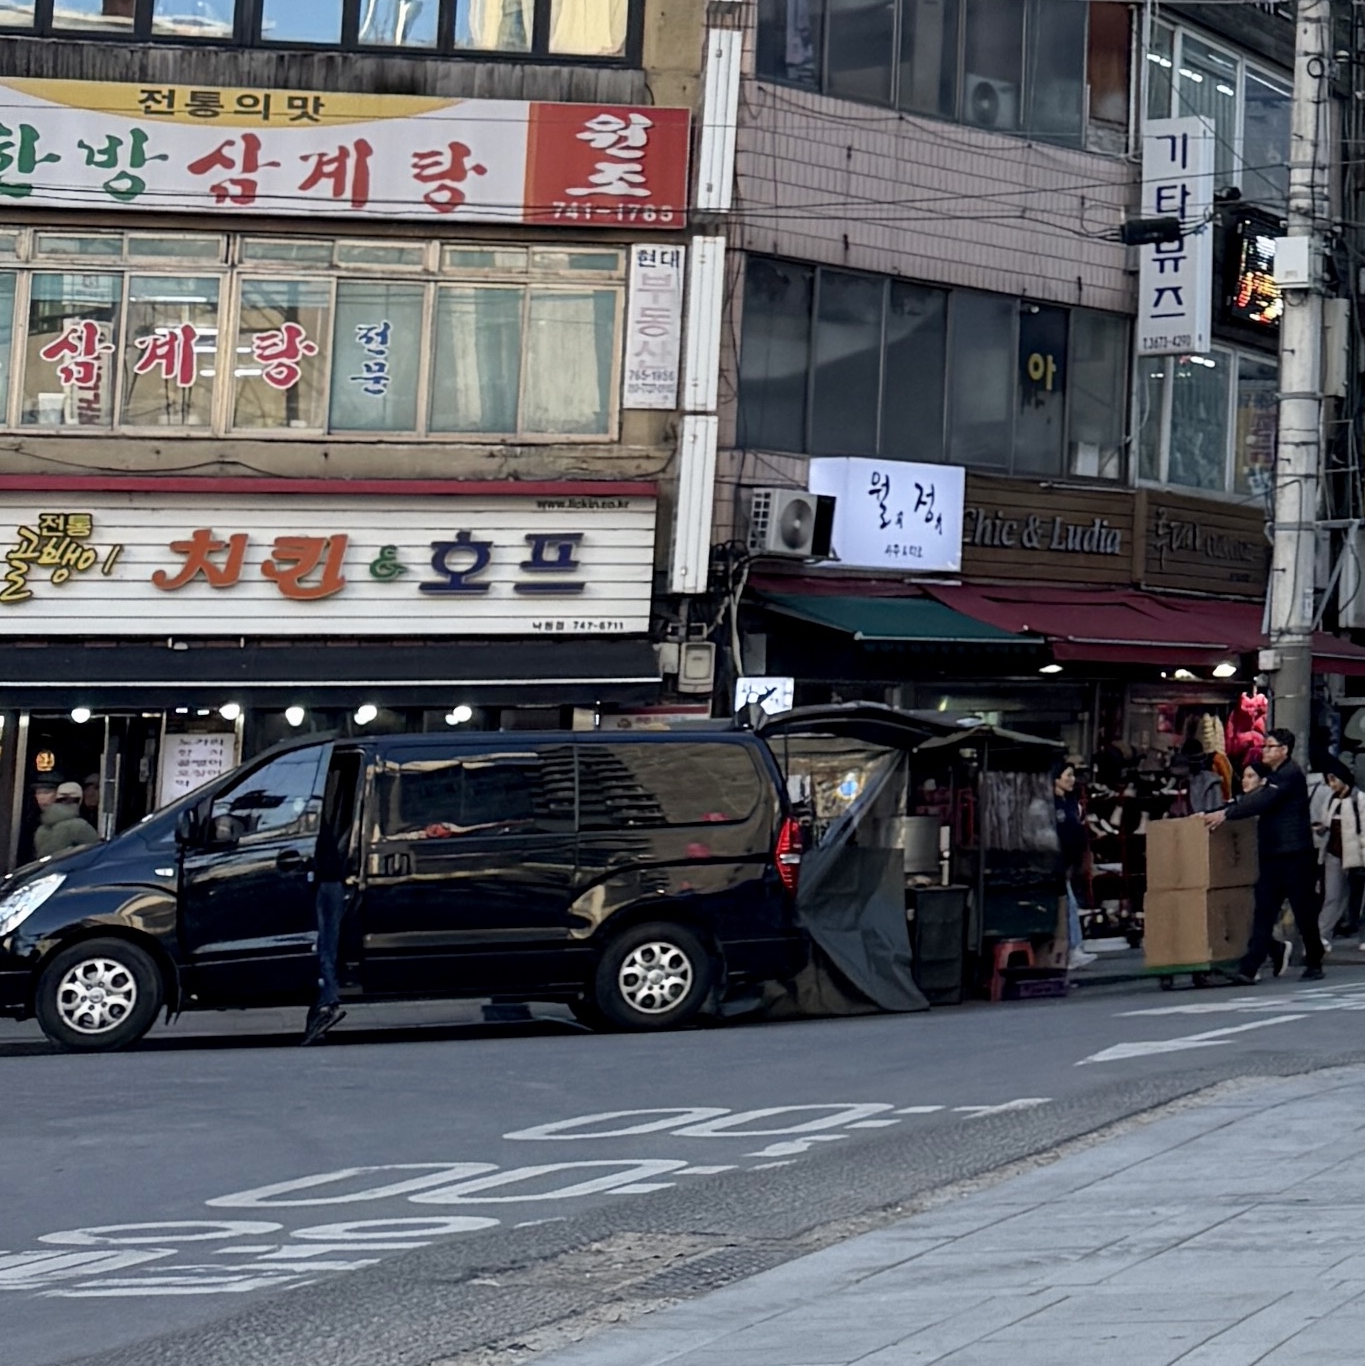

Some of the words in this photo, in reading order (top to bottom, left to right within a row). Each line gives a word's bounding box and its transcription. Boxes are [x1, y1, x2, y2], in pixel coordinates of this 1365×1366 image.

[39, 513, 93, 537] 전통
[152, 528, 350, 600] 치킨
[418, 530, 585, 595] 호프
